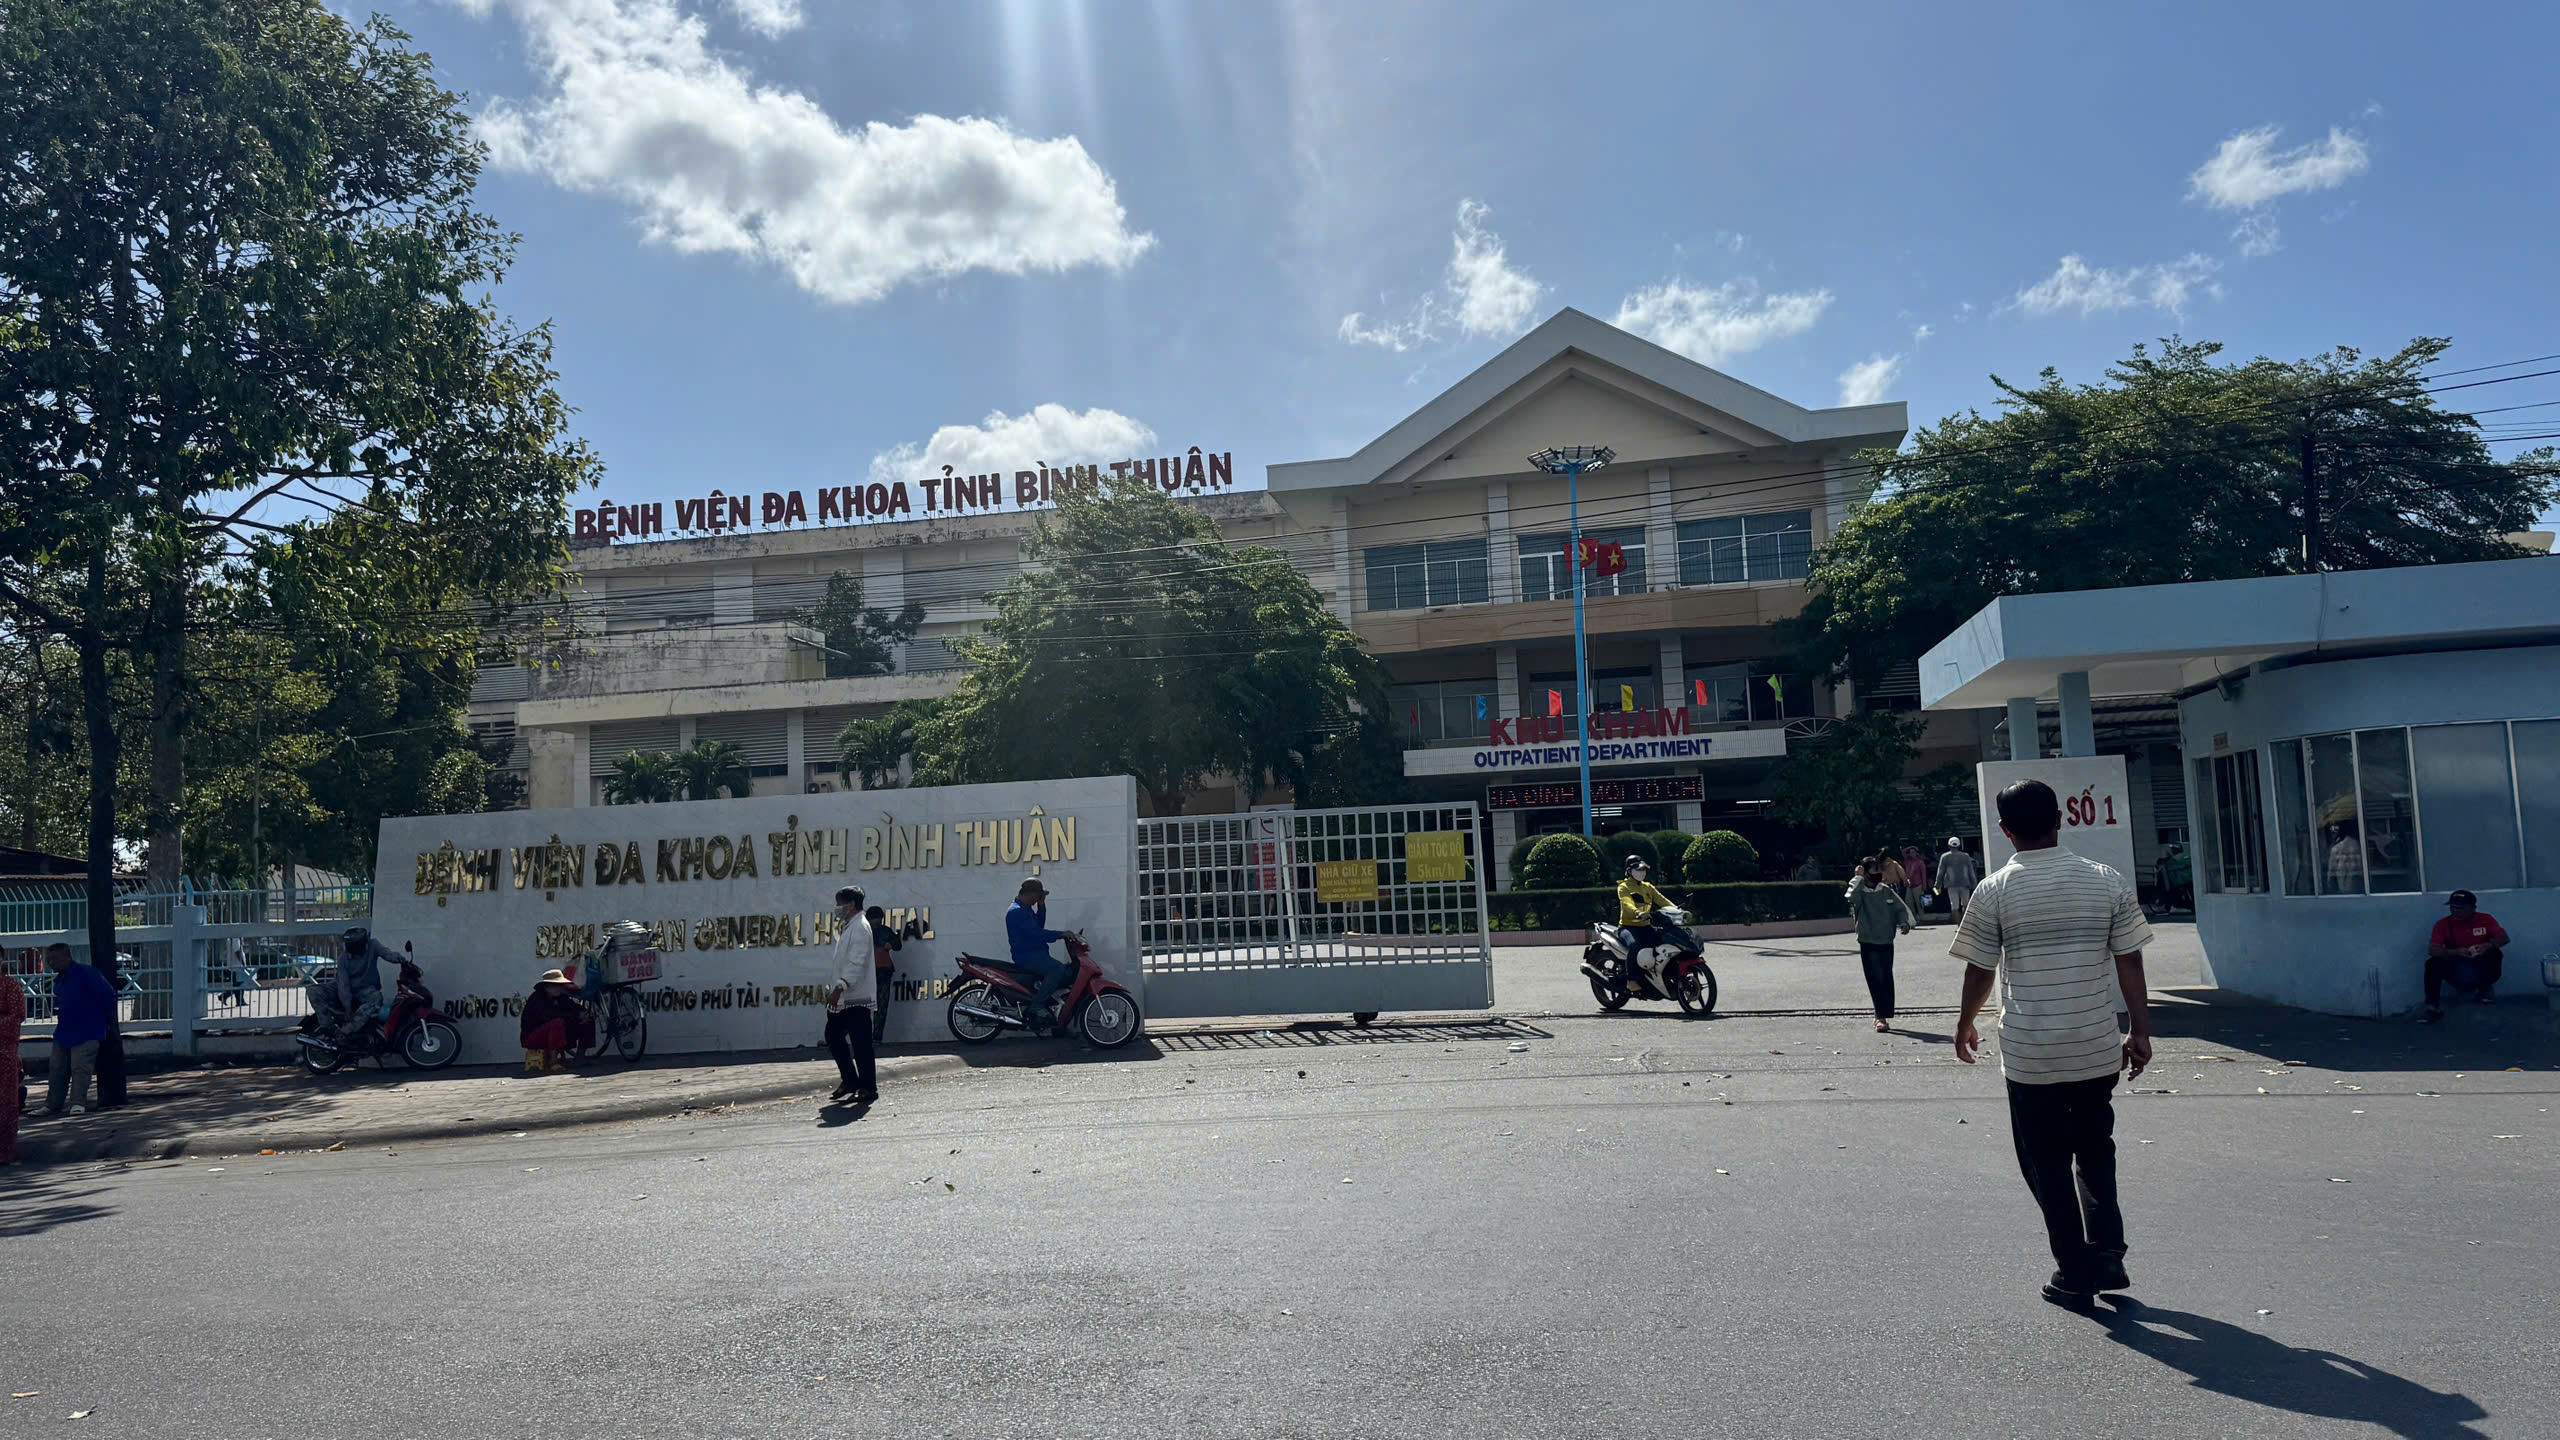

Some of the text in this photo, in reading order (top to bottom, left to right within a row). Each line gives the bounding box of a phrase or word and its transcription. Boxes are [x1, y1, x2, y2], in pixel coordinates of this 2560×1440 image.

[575, 499, 662, 545] BỆNH
[675, 490, 750, 534] VIỆN
[763, 491, 807, 523] ĐA
[819, 482, 911, 519] KHOA
[920, 465, 1001, 512] TỈNH
[1490, 716, 1564, 746] KHU
[1474, 738, 1712, 768] OUTPATIENT DEPARTMENT
[2067, 784, 2117, 826] SỐ 1
[415, 805, 1076, 907] BỆNH VIỆN ĐA KHOA TỈNH BÌNH THUẬN
[1361, 865, 1373, 876] XE
[693, 913, 805, 951] GENERAL
[636, 986, 697, 1012] HƯỜNG
[701, 983, 732, 1010] PHÚ
[737, 981, 760, 1008] TÀI
[894, 973, 928, 1001] TỈNH
